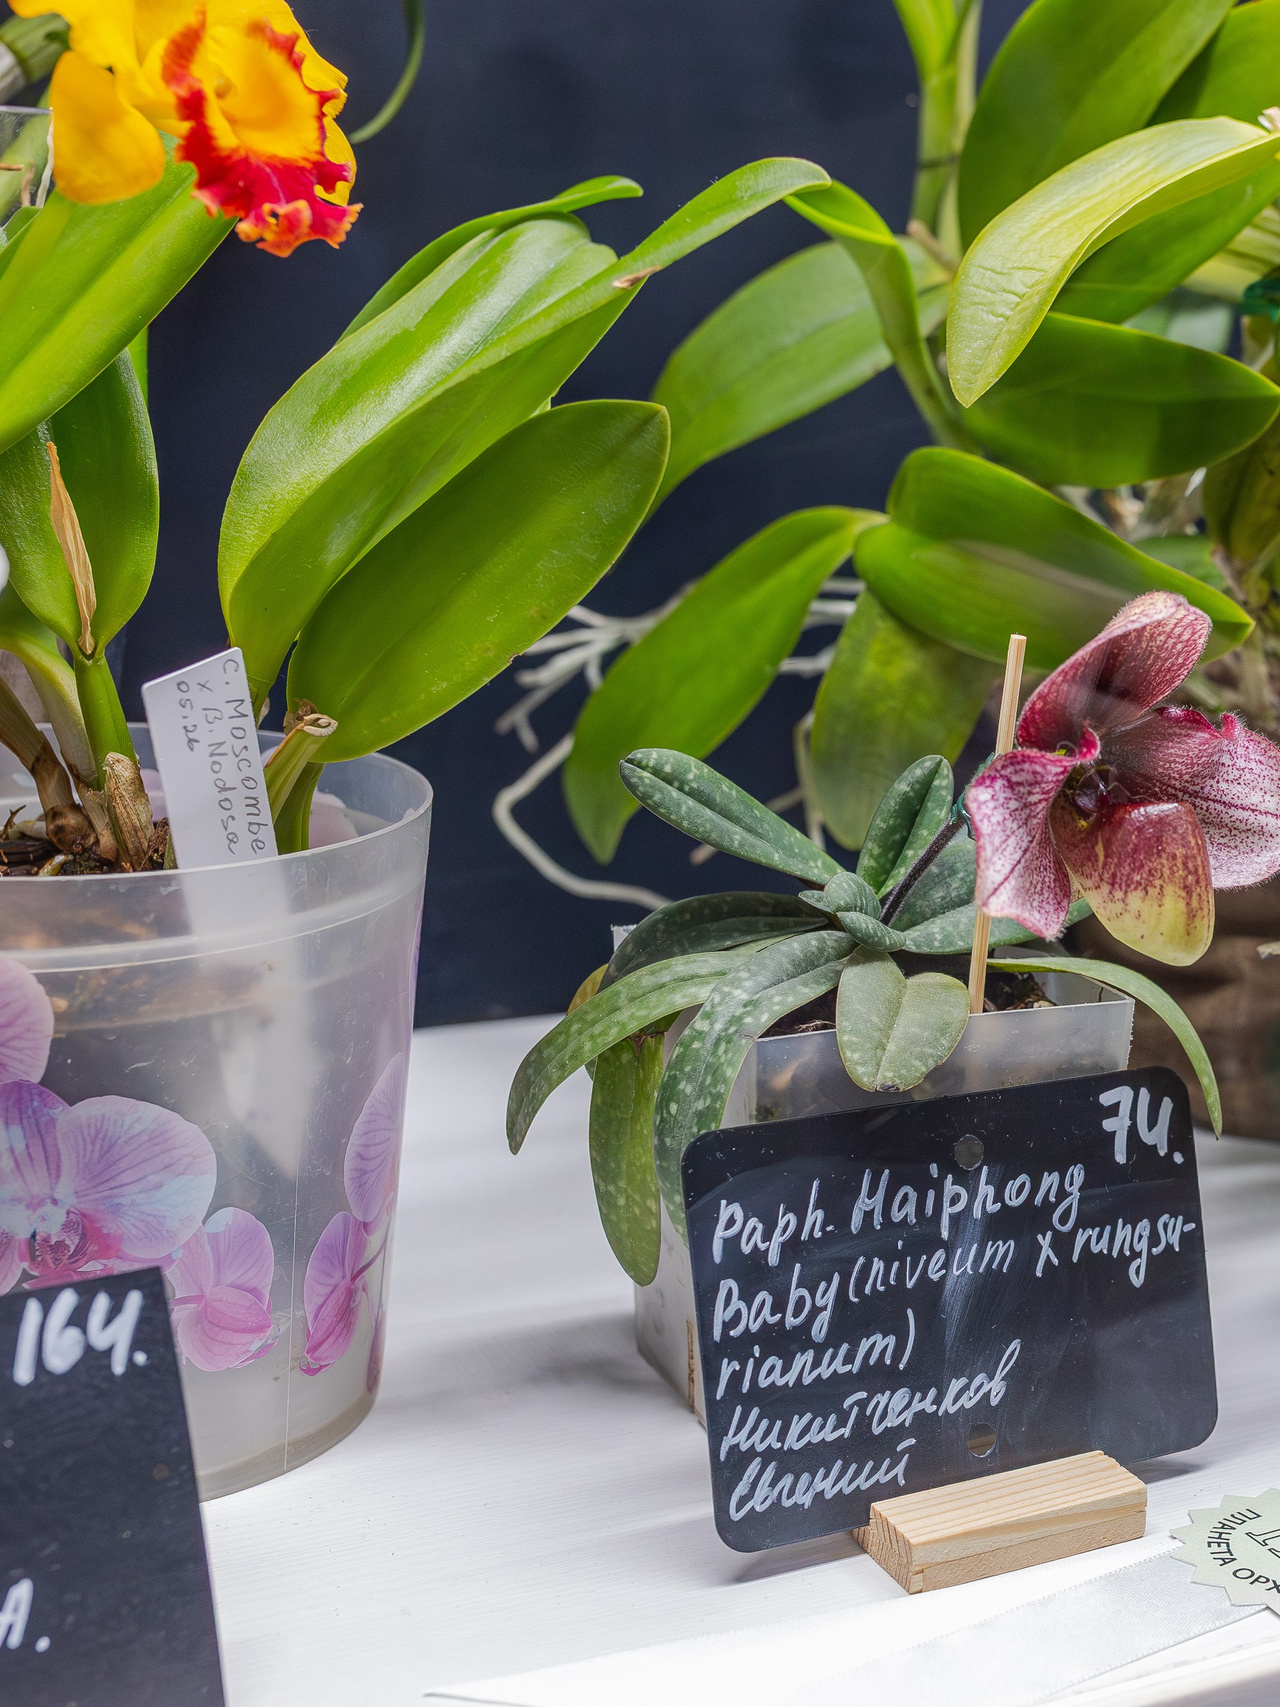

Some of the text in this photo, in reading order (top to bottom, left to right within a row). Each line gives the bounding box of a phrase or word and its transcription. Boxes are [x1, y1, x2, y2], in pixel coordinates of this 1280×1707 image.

[712, 1163, 1085, 1267] Paph. Haiphong
[1072, 1214, 1196, 1288] rungsu-
[13, 1288, 147, 1386] 164.
[716, 1308, 915, 1400] rianum)
[720, 1339, 1021, 1461] Никитченков
[729, 1438, 916, 1521] Евгений
[1207, 1508, 1262, 1567] ПЛАНЕТА
